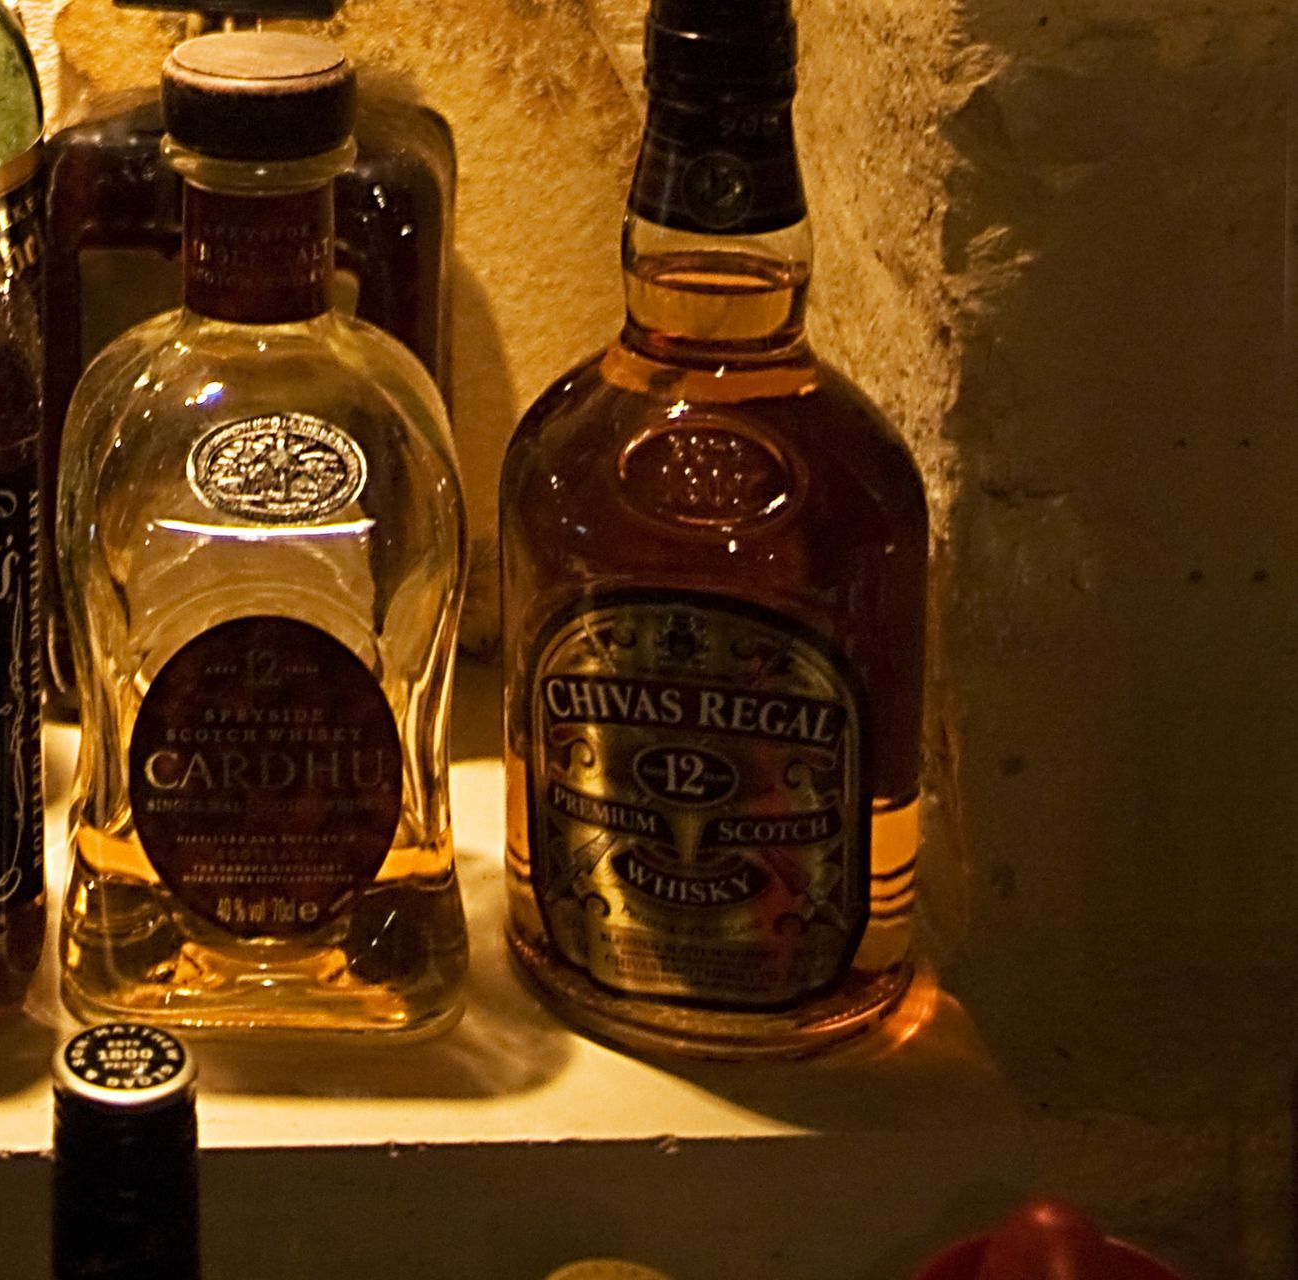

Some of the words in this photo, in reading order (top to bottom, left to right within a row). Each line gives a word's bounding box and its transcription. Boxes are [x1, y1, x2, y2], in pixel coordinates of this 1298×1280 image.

[244, 648, 283, 688] 12
[545, 676, 685, 725] CHIVAS
[697, 689, 838, 743] REGAL
[165, 727, 257, 744] SCOTCH
[267, 727, 363, 742] WHISKY
[664, 753, 706, 796] 12
[552, 786, 657, 834] PREMIUM
[717, 814, 830, 842] SCOTCH
[627, 856, 752, 905] WHISKY
[97, 1048, 154, 1061] 1800
